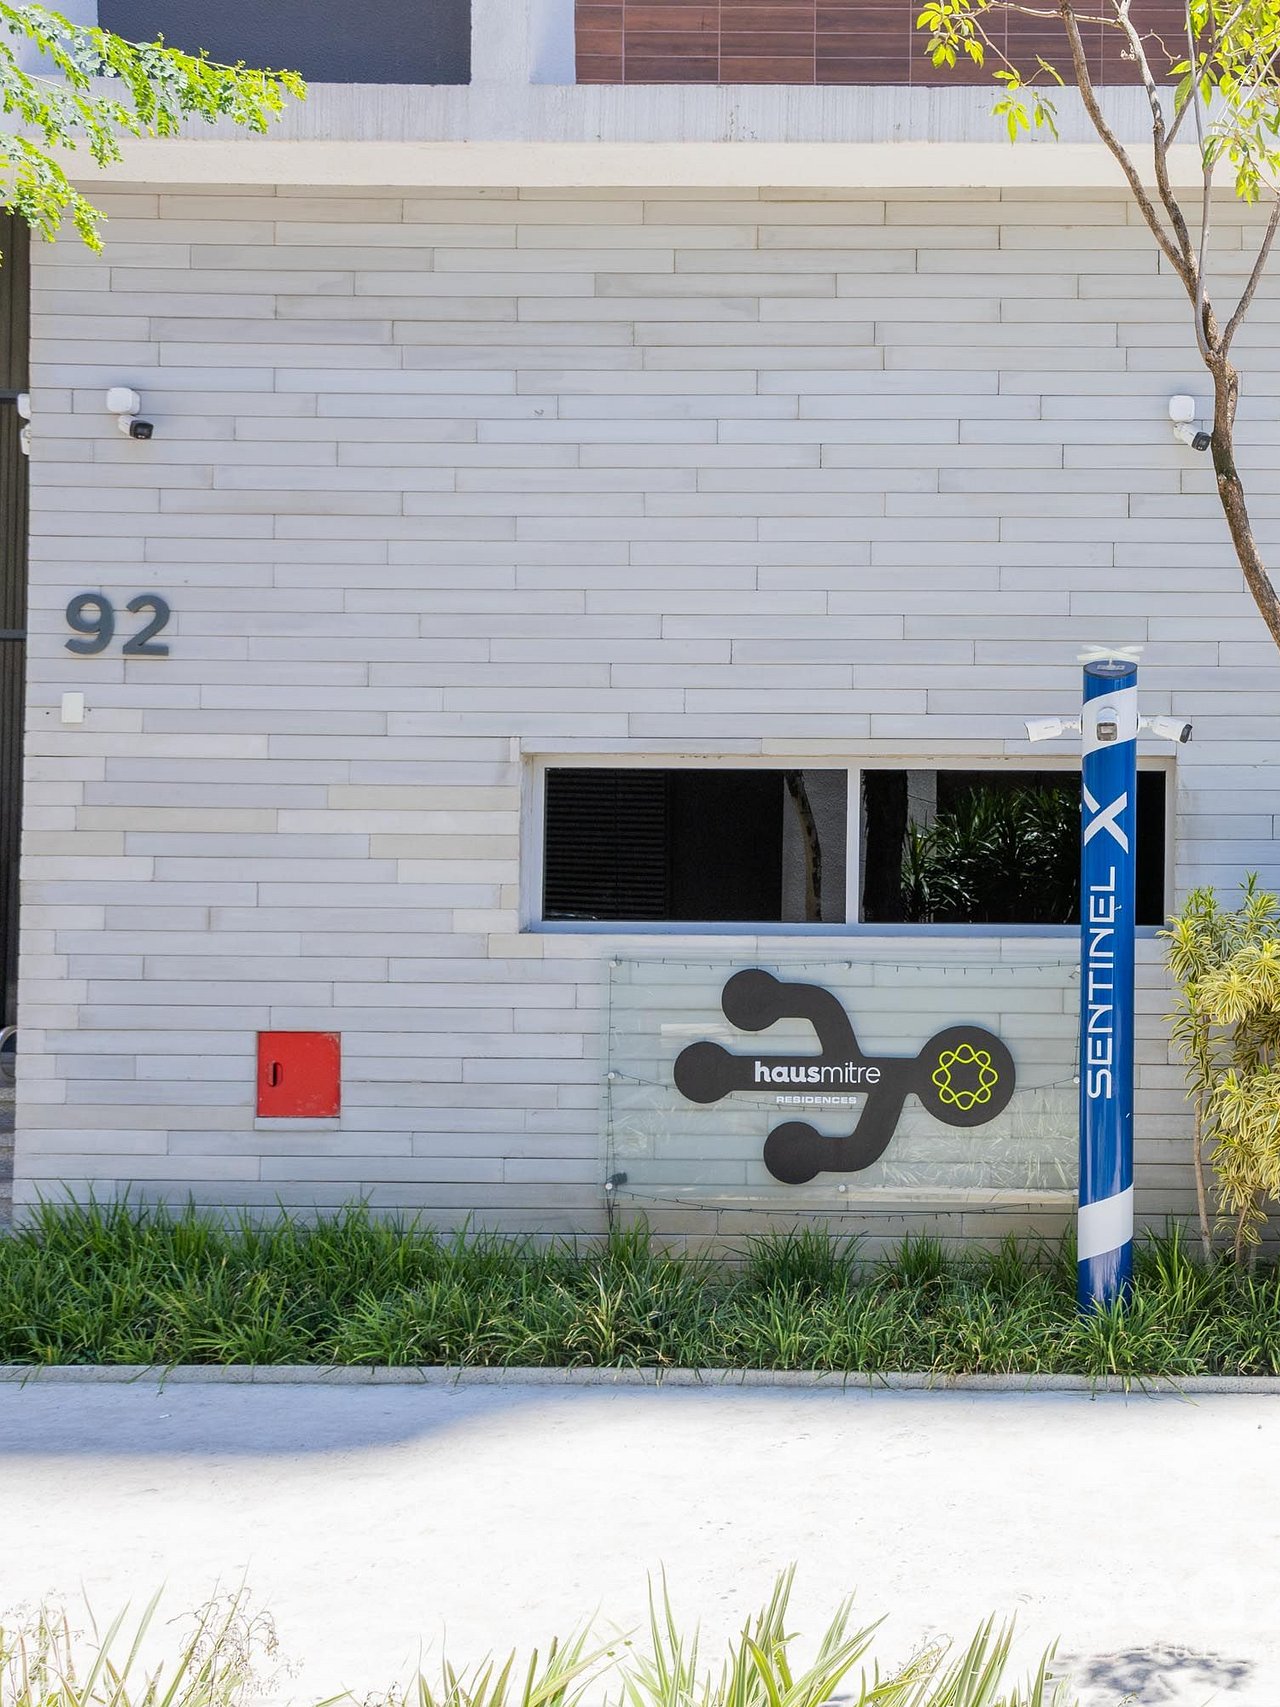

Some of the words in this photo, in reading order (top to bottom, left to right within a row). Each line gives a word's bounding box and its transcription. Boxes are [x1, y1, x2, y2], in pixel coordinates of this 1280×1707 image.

[64, 593, 170, 656] 92
[1083, 783, 1129, 854] X
[1087, 866, 1116, 1100] SENTINEL
[754, 1060, 881, 1084] hausmitre
[776, 1095, 858, 1105] RESIDENCES
